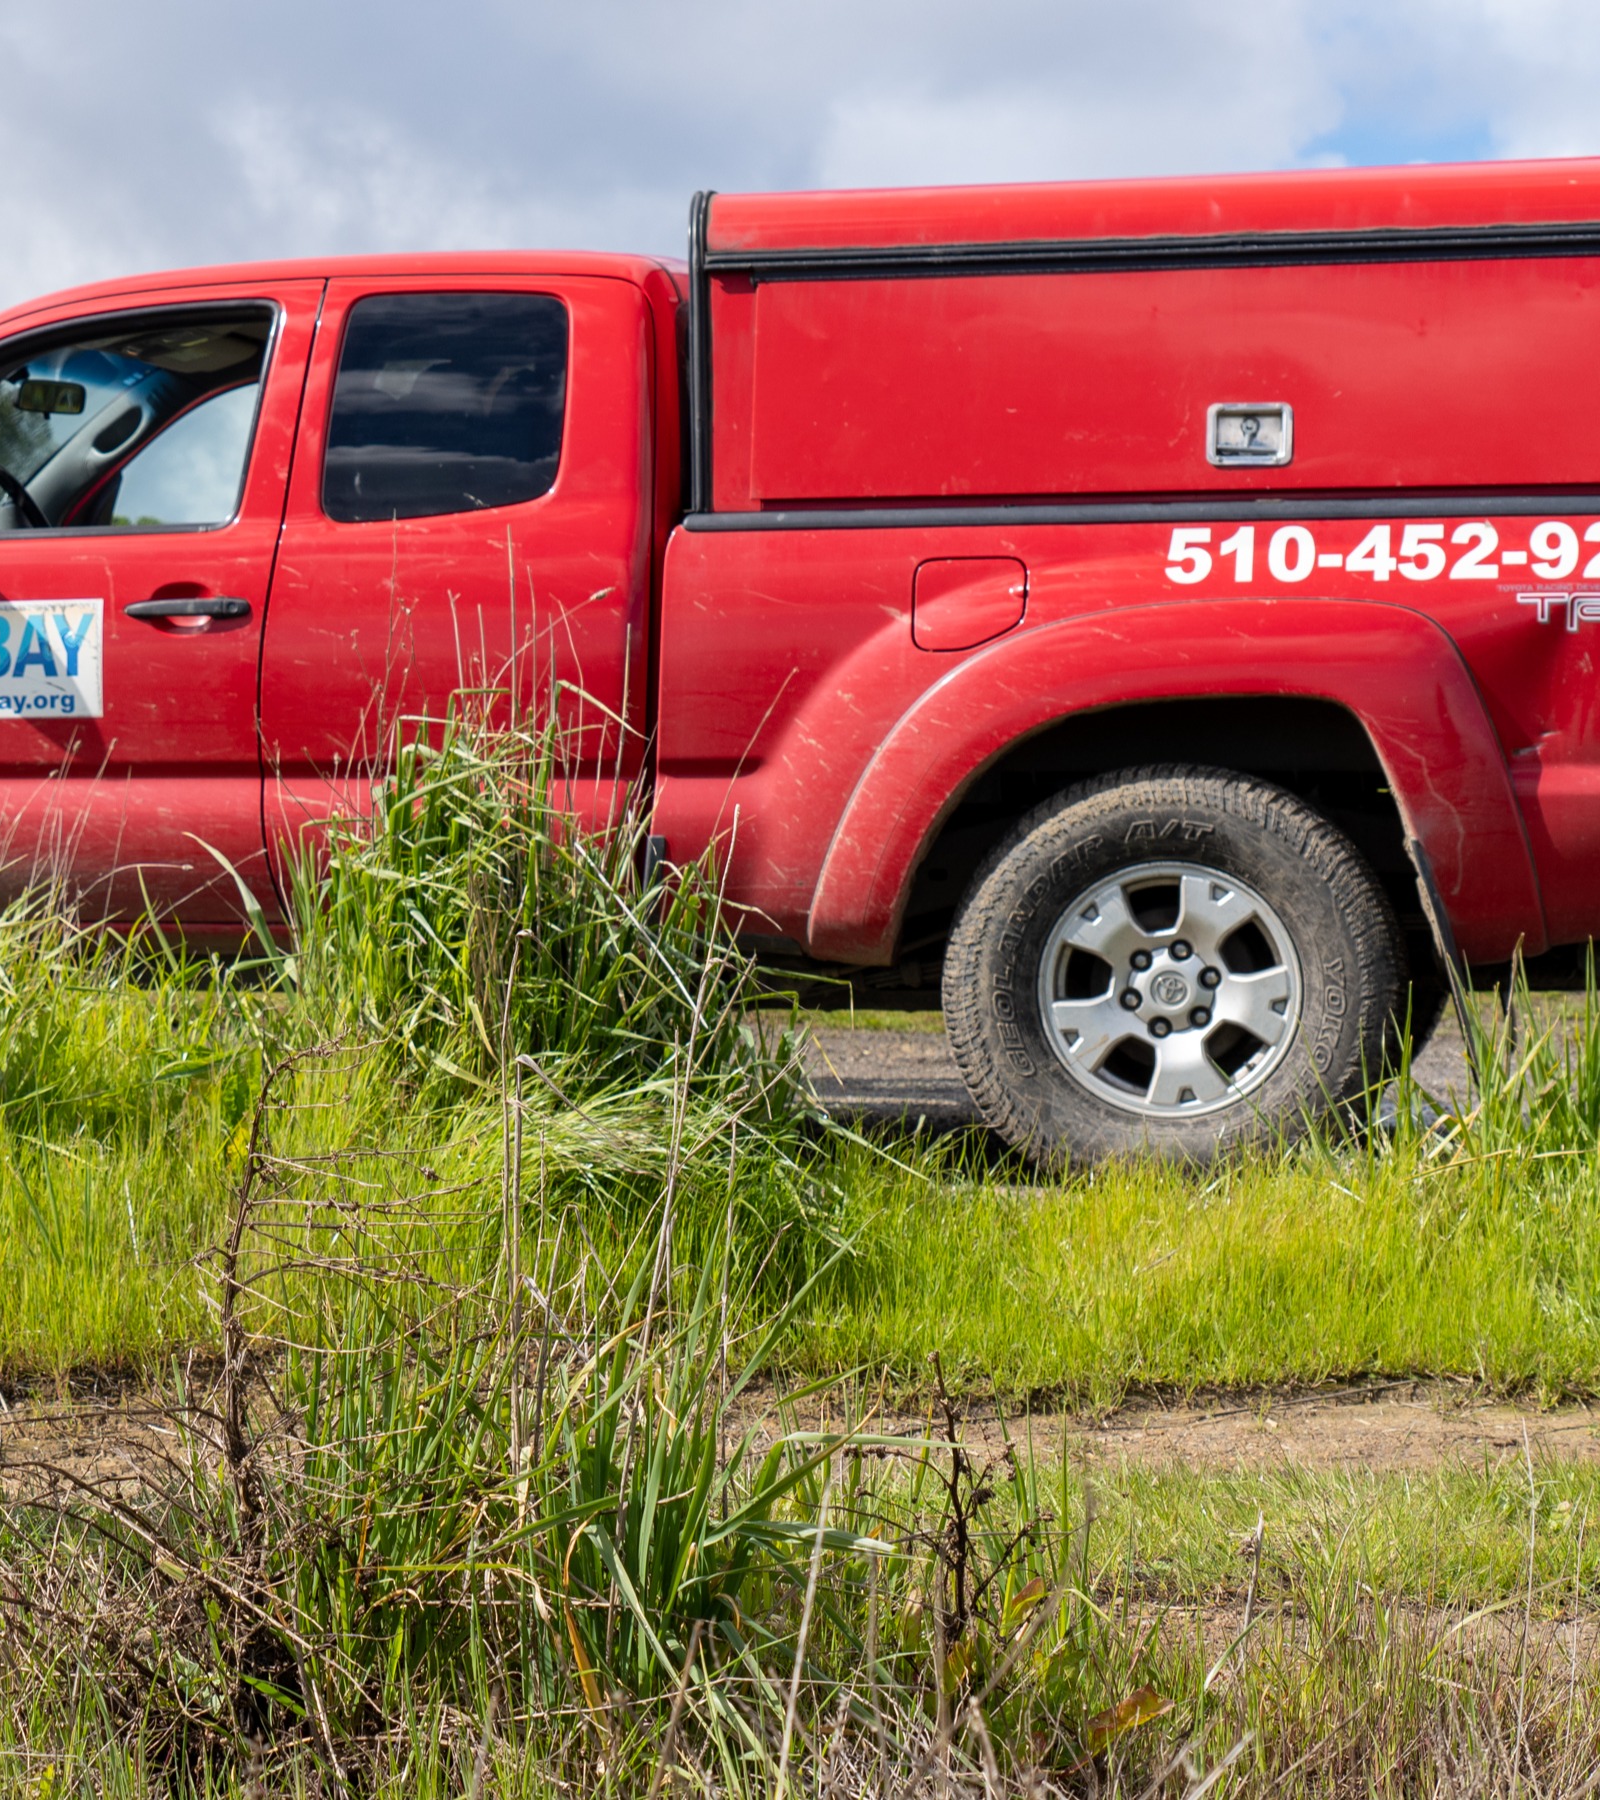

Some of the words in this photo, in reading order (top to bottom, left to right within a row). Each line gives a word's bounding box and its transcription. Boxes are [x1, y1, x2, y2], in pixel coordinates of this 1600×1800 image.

[1497, 584, 1533, 592] TOYOTA
[1536, 583, 1573, 592] RACING
[992, 834, 1104, 1079] GEOLANDAR
[1124, 818, 1216, 844] A/T
